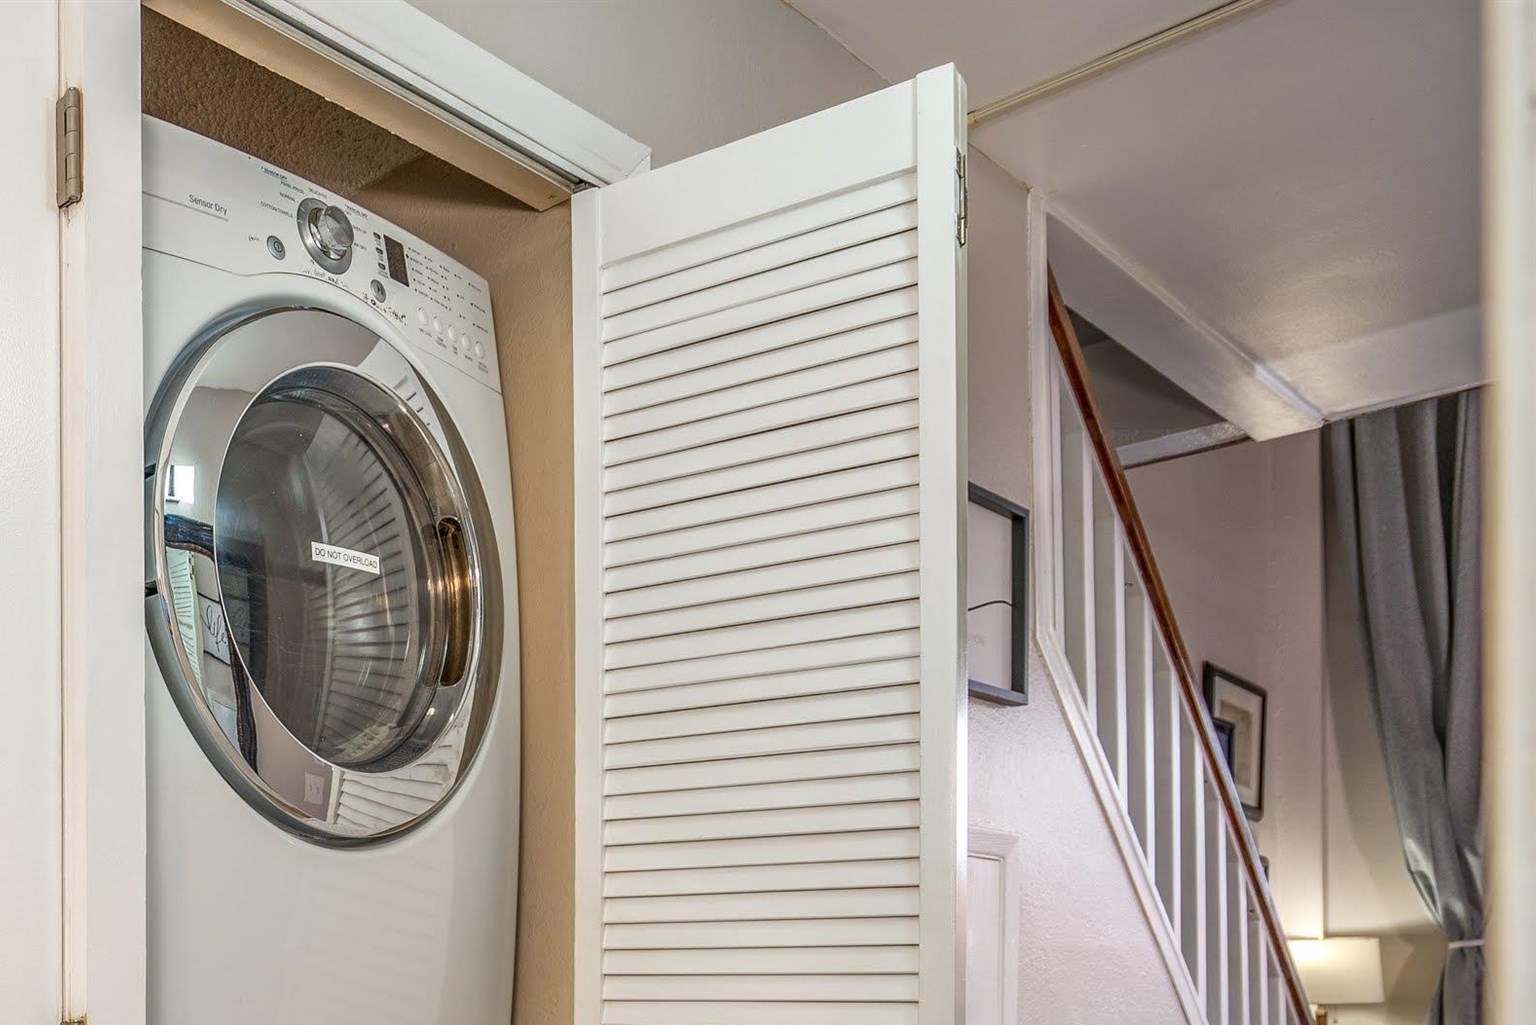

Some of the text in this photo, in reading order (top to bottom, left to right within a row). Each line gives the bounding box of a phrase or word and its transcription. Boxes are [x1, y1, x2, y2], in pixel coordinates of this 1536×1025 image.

[189, 194, 228, 216] Sensor Dry
[315, 547, 377, 568] DO NOT OVERLOAD
